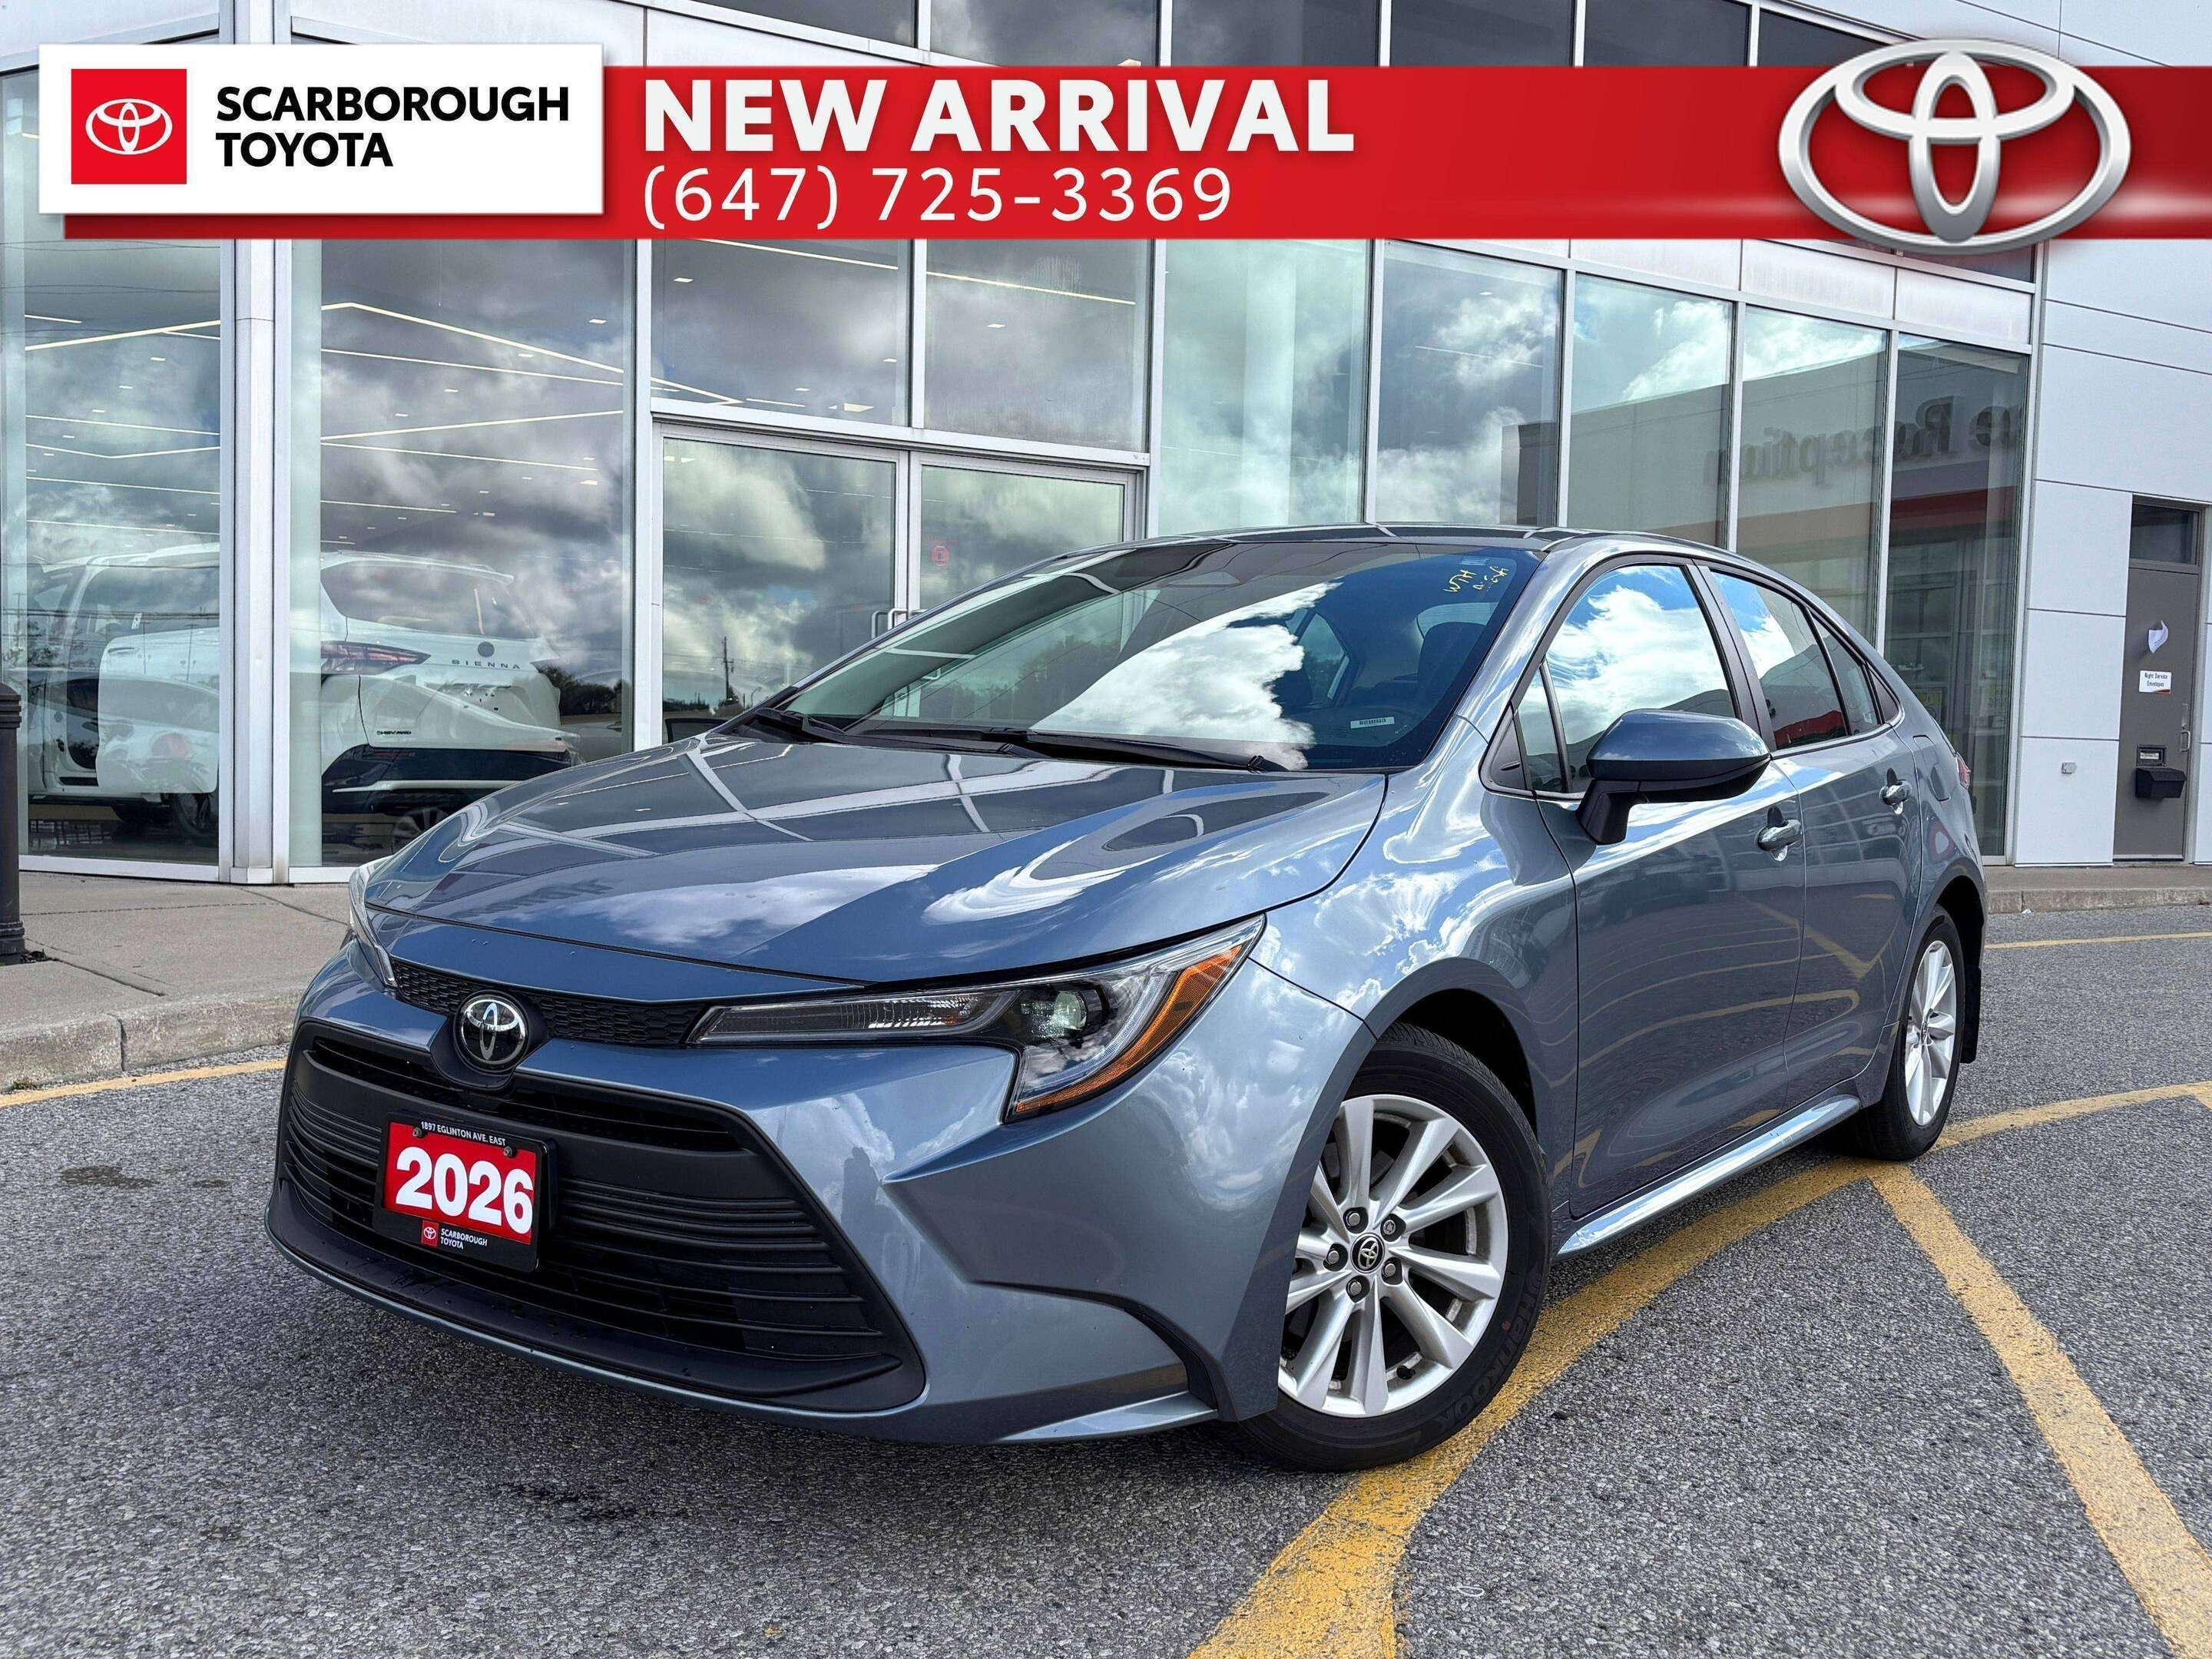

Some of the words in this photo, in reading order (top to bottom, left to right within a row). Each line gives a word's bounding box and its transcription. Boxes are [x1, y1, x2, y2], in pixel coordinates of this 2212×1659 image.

[451, 659, 520, 669] SIENNA
[421, 1121, 435, 1131] 1897
[437, 1124, 472, 1140] EGLINTON
[472, 1133, 488, 1143] AVE.
[488, 1135, 506, 1147] EAST
[396, 1146, 535, 1234] 2026
[440, 1237, 464, 1250] TOYOTA
[441, 1228, 488, 1247] SCARBOROUGH
